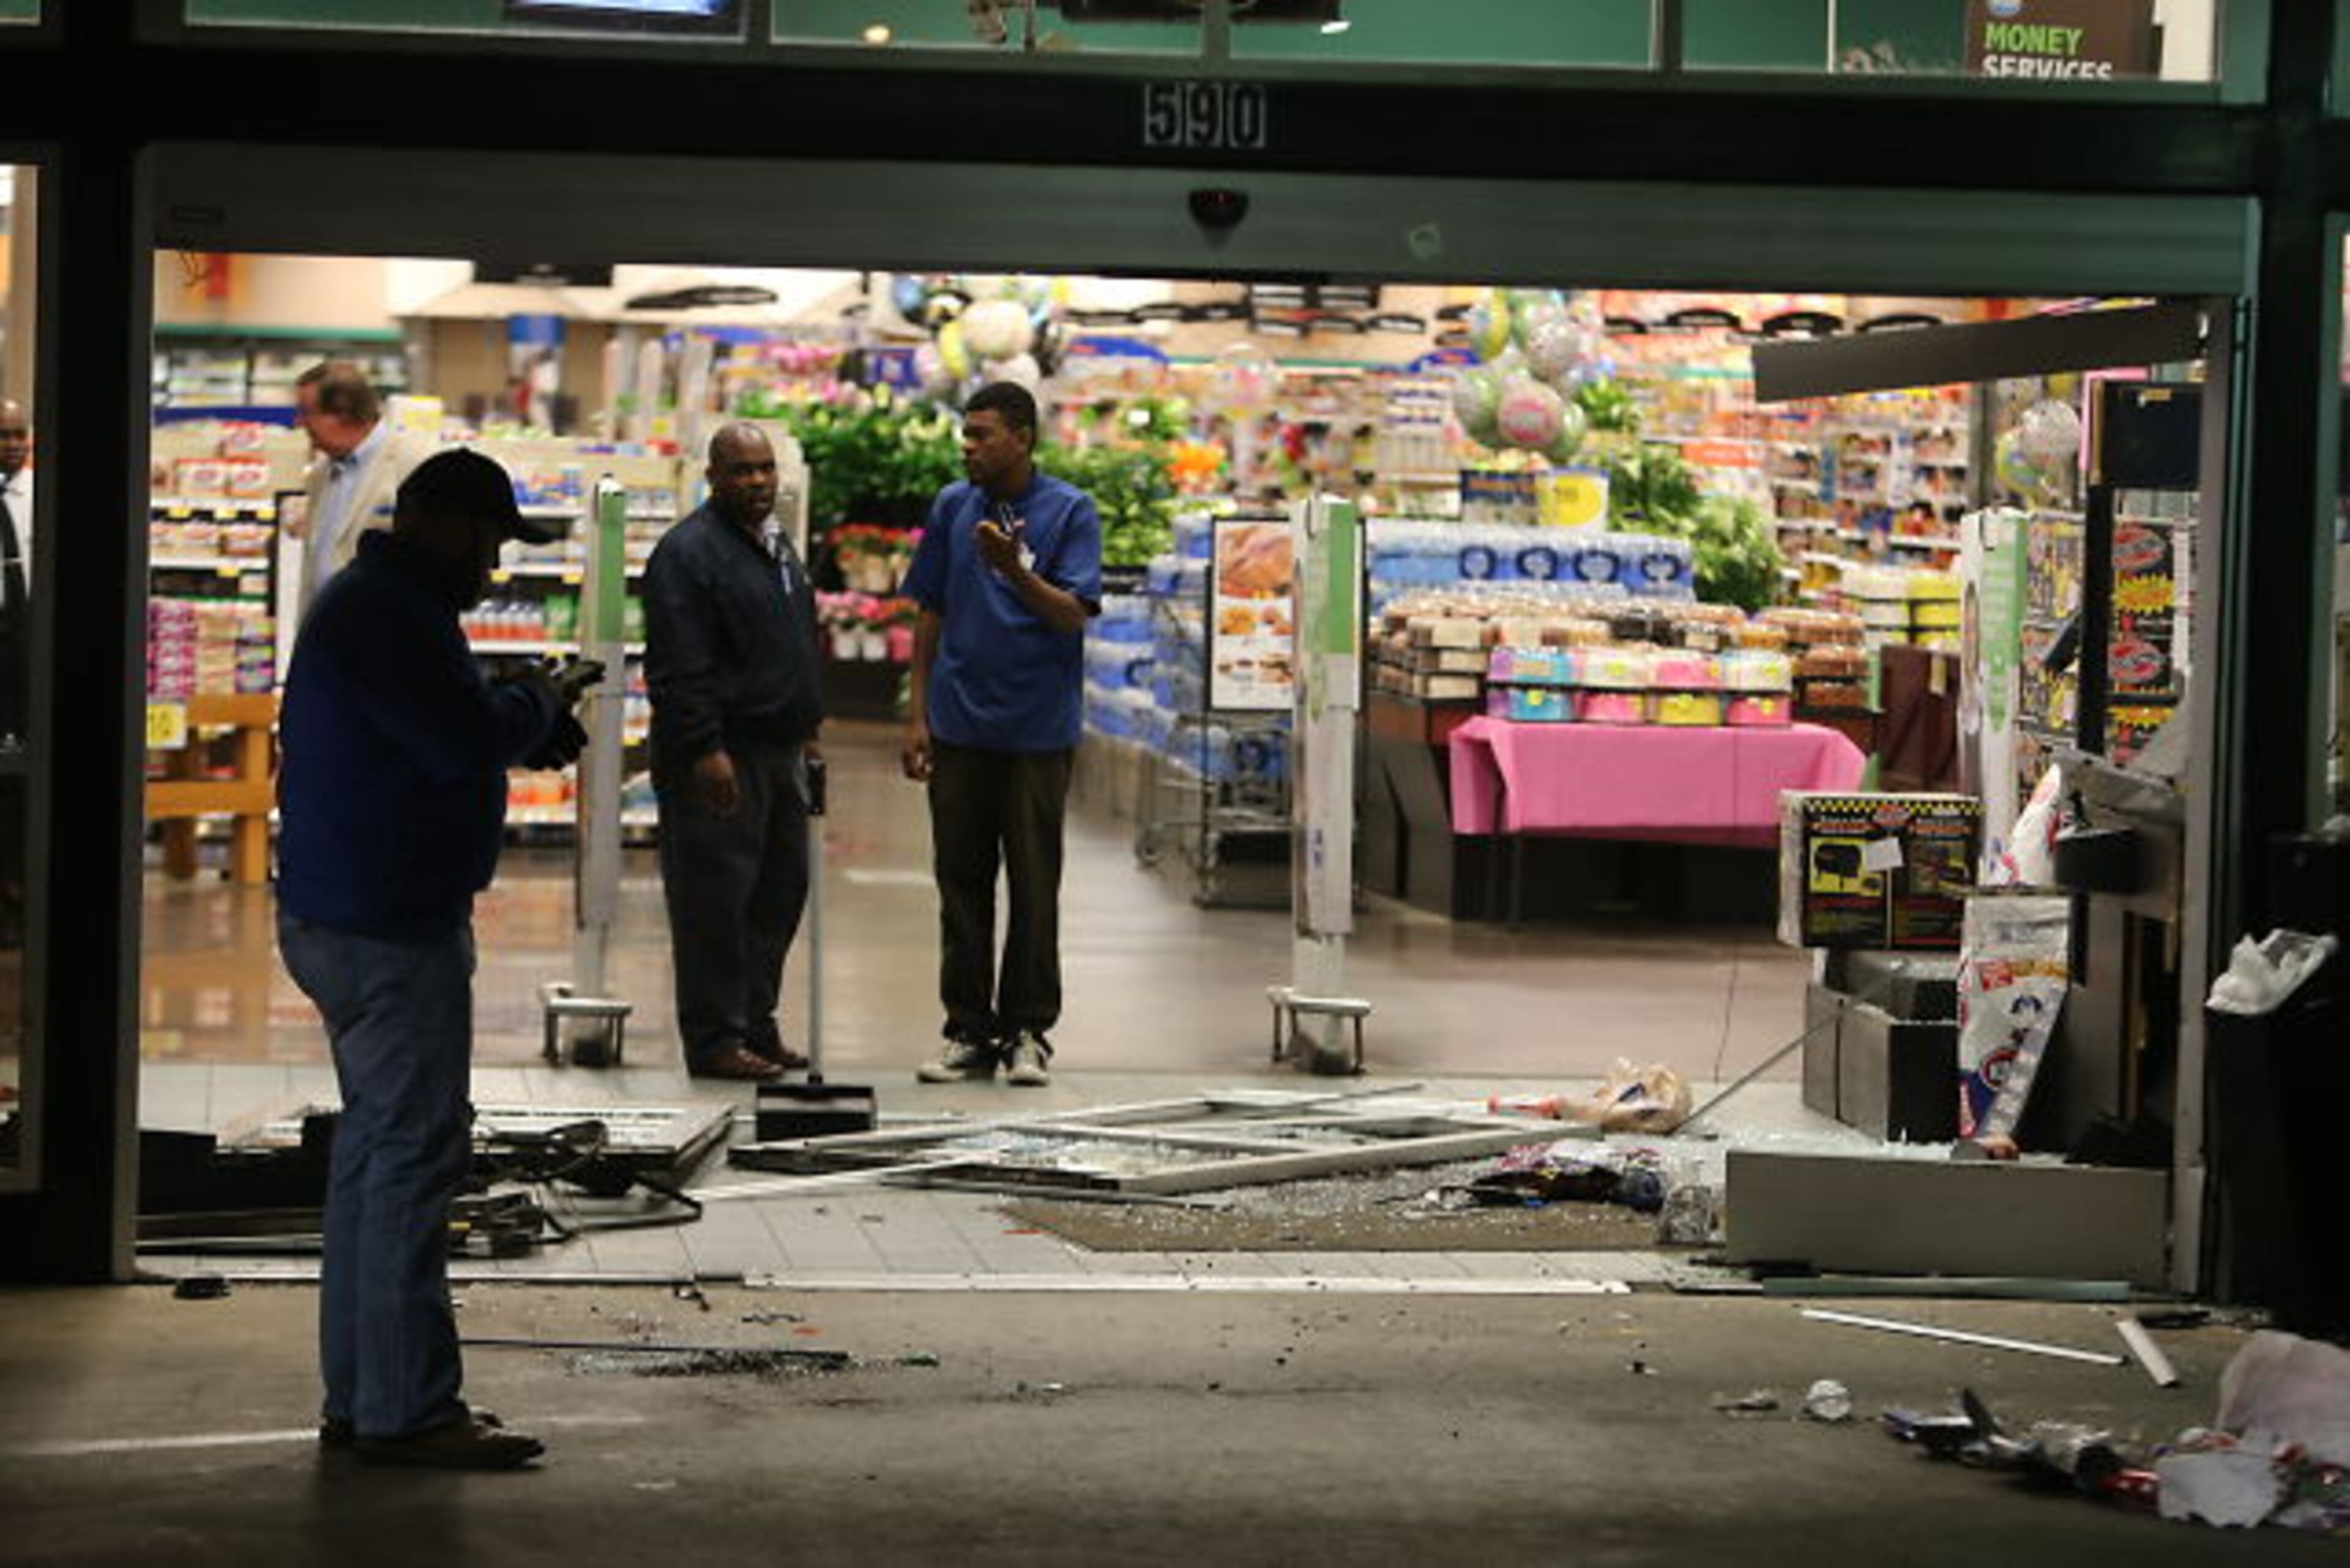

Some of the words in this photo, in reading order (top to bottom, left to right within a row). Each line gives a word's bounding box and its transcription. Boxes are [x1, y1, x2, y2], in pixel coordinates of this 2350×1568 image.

[1985, 22, 2083, 56] MONEY
[1982, 54, 2113, 80] SERVICES
[1144, 82, 1266, 148] 590
